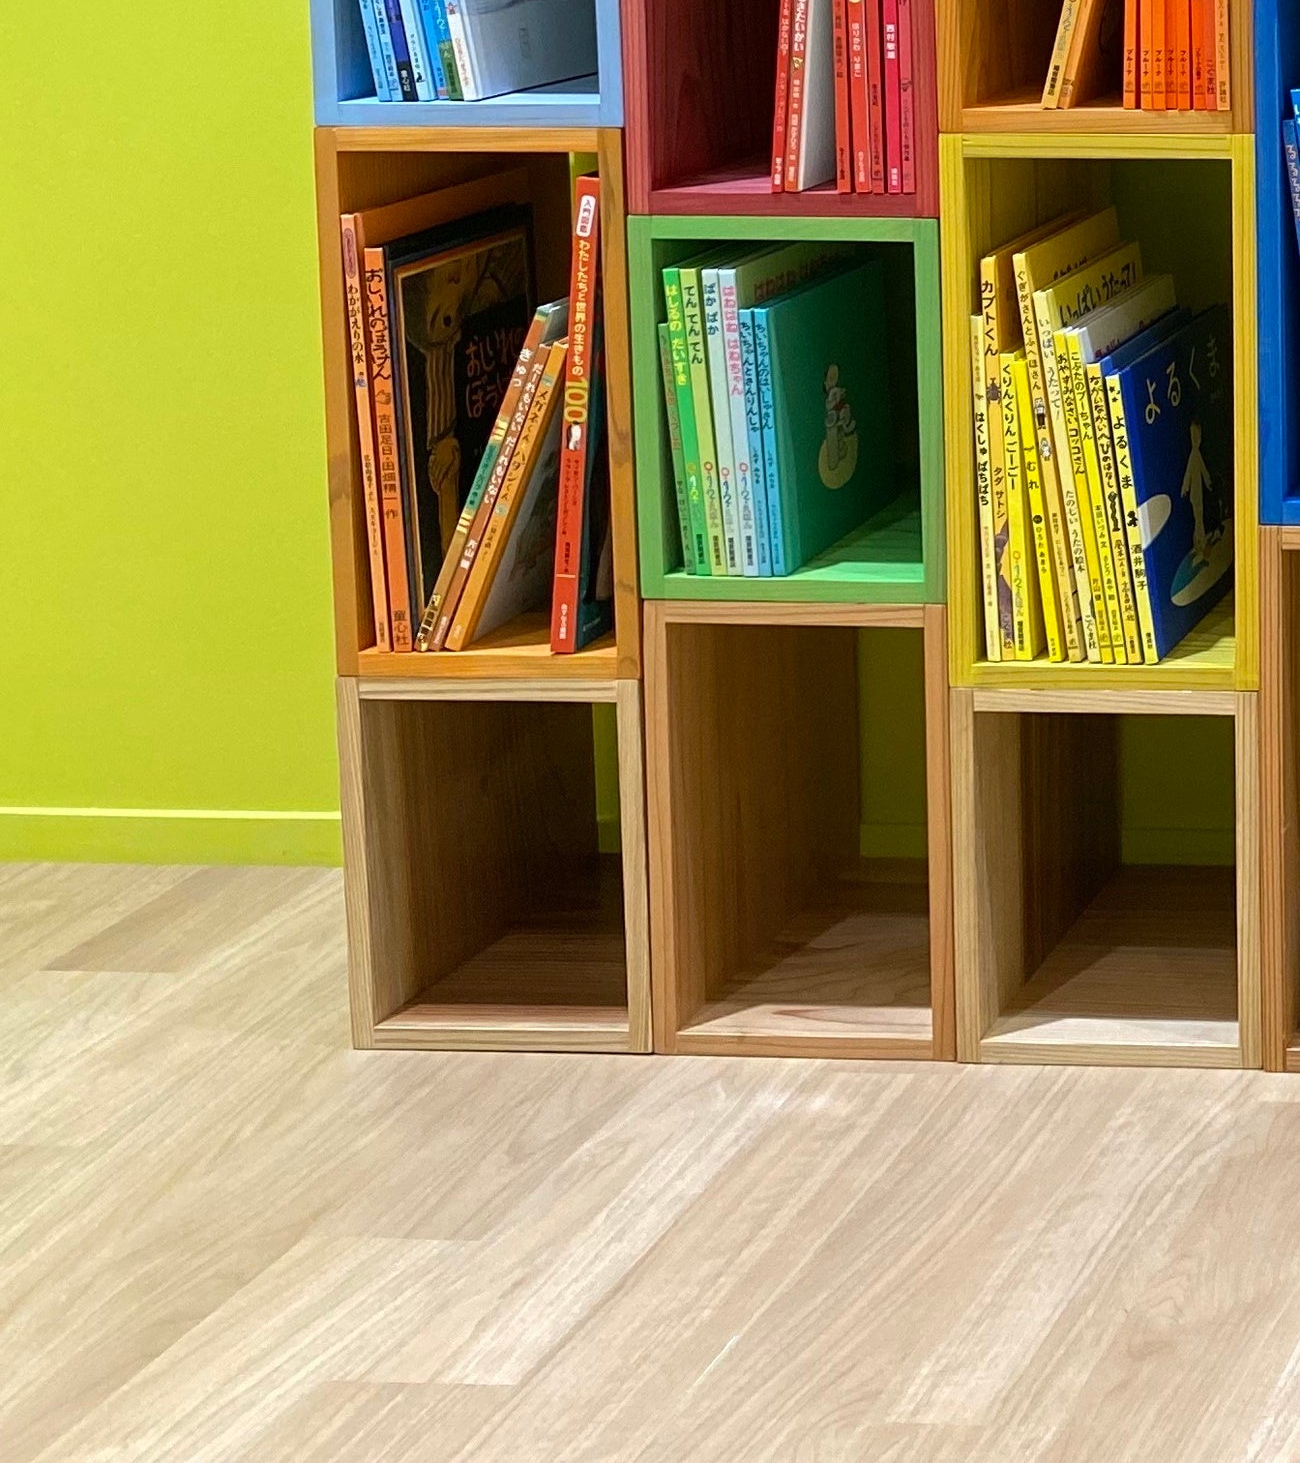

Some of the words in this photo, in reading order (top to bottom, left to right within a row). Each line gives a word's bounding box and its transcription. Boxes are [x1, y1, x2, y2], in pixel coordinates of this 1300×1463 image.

[348, 283, 364, 364] わかがえりの水
[365, 269, 391, 380] おしいれのぼうけん
[572, 240, 591, 377] わたしたちと世界の生きもの
[510, 363, 544, 431] だーれもいない
[512, 348, 533, 388] ぎゅっ
[1001, 364, 1017, 437] くりんくりん
[485, 434, 519, 504] だーれもいない
[1112, 415, 1134, 489] よるくま
[1065, 490, 1078, 524] たのしい
[1131, 543, 1147, 591] 酒井駒子
